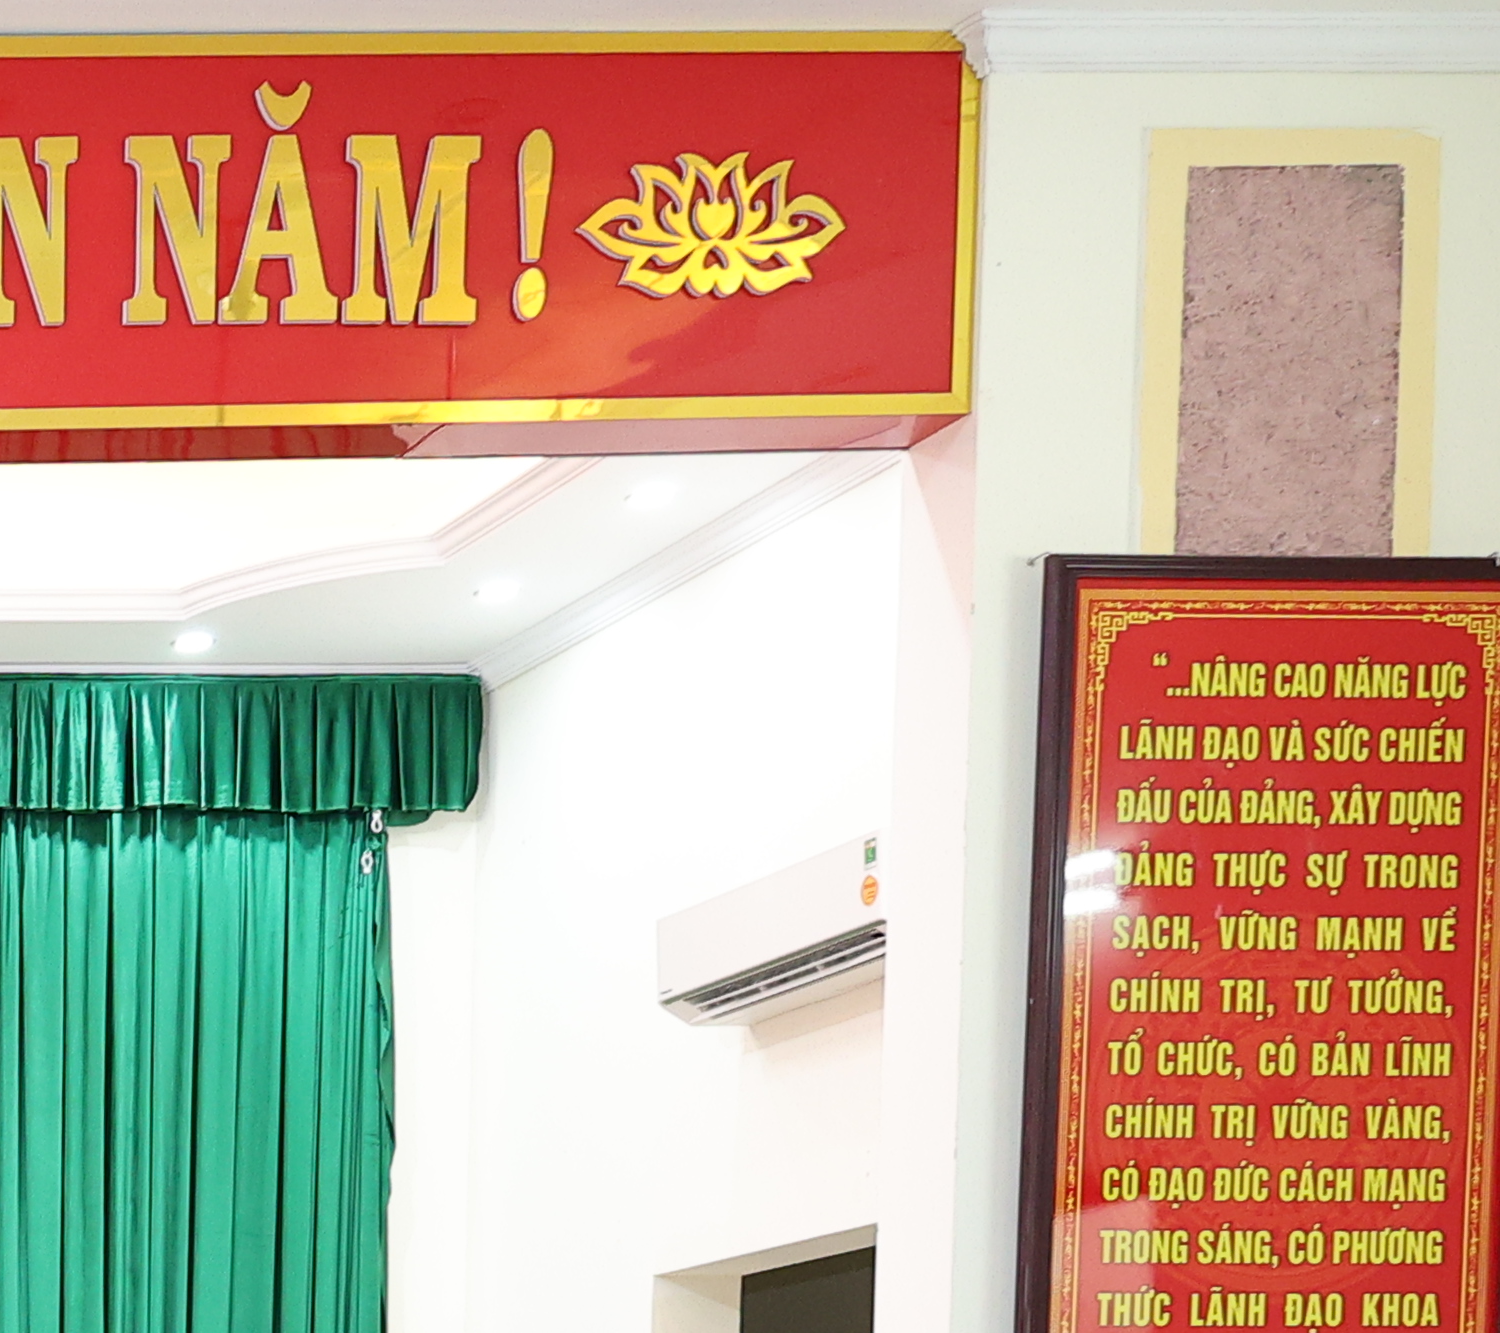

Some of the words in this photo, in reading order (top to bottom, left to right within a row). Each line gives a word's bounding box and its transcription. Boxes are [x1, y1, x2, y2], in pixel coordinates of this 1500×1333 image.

[1274, 662, 1327, 698] CAO
[1334, 656, 1409, 699] NĂNG
[1416, 661, 1466, 707] LỰC
[1119, 719, 1194, 760] LÃNH
[1202, 726, 1260, 769] ĐẠO
[1269, 719, 1305, 761] VÀ
[1313, 720, 1370, 762] SỨC
[1379, 717, 1464, 763] CHIẾN
[1116, 776, 1171, 825] ĐẤU
[1178, 777, 1233, 824] CỦA
[1239, 778, 1321, 829] ĐẢNG,
[1328, 783, 1383, 825] XÂY
[1388, 788, 1462, 833] DỰNG
[1113, 840, 1194, 888] ĐẢNG
[1213, 849, 1286, 895] THỰC
[1306, 850, 1348, 896] SỰ
[1363, 854, 1458, 889] TRONG
[1111, 913, 1199, 958] SẠCH,
[1219, 909, 1297, 951] VỮNG
[1316, 916, 1403, 959] MẠNH
[1422, 906, 1456, 952] VỀ
[1109, 971, 1201, 1013] CHÍNH
[1219, 979, 1274, 1021] TRỊ,
[1294, 976, 1333, 1014] TƯ
[1348, 968, 1452, 1018] TƯỞNG,
[1107, 1027, 1144, 1076] TỔ
[1157, 1034, 1243, 1080] CHỨC,
[1258, 1035, 1296, 1077] CÓ
[1311, 1030, 1371, 1077] BẢN
[1385, 1036, 1451, 1077] LĨNH
[1105, 1097, 1194, 1139] CHÍNH
[1210, 1104, 1255, 1147] TRỊ
[1272, 1098, 1349, 1140] VỮNG
[1365, 1098, 1450, 1144] VÀNG,
[1102, 1160, 1140, 1201] CÓ
[1148, 1167, 1205, 1209] ĐẠO
[1213, 1160, 1270, 1202] ĐỨC
[1279, 1160, 1354, 1202] CÁCH
[1362, 1168, 1446, 1210] MẠNG
[1098, 1229, 1189, 1265] TRONG
[1197, 1223, 1279, 1269] SÁNG,
[1288, 1223, 1324, 1265] CÓ
[1332, 1227, 1443, 1265] PHƯƠNG
[1096, 1284, 1171, 1327] THỨC
[1190, 1286, 1266, 1327] LÃNH
[1362, 1293, 1439, 1327] KHOA
